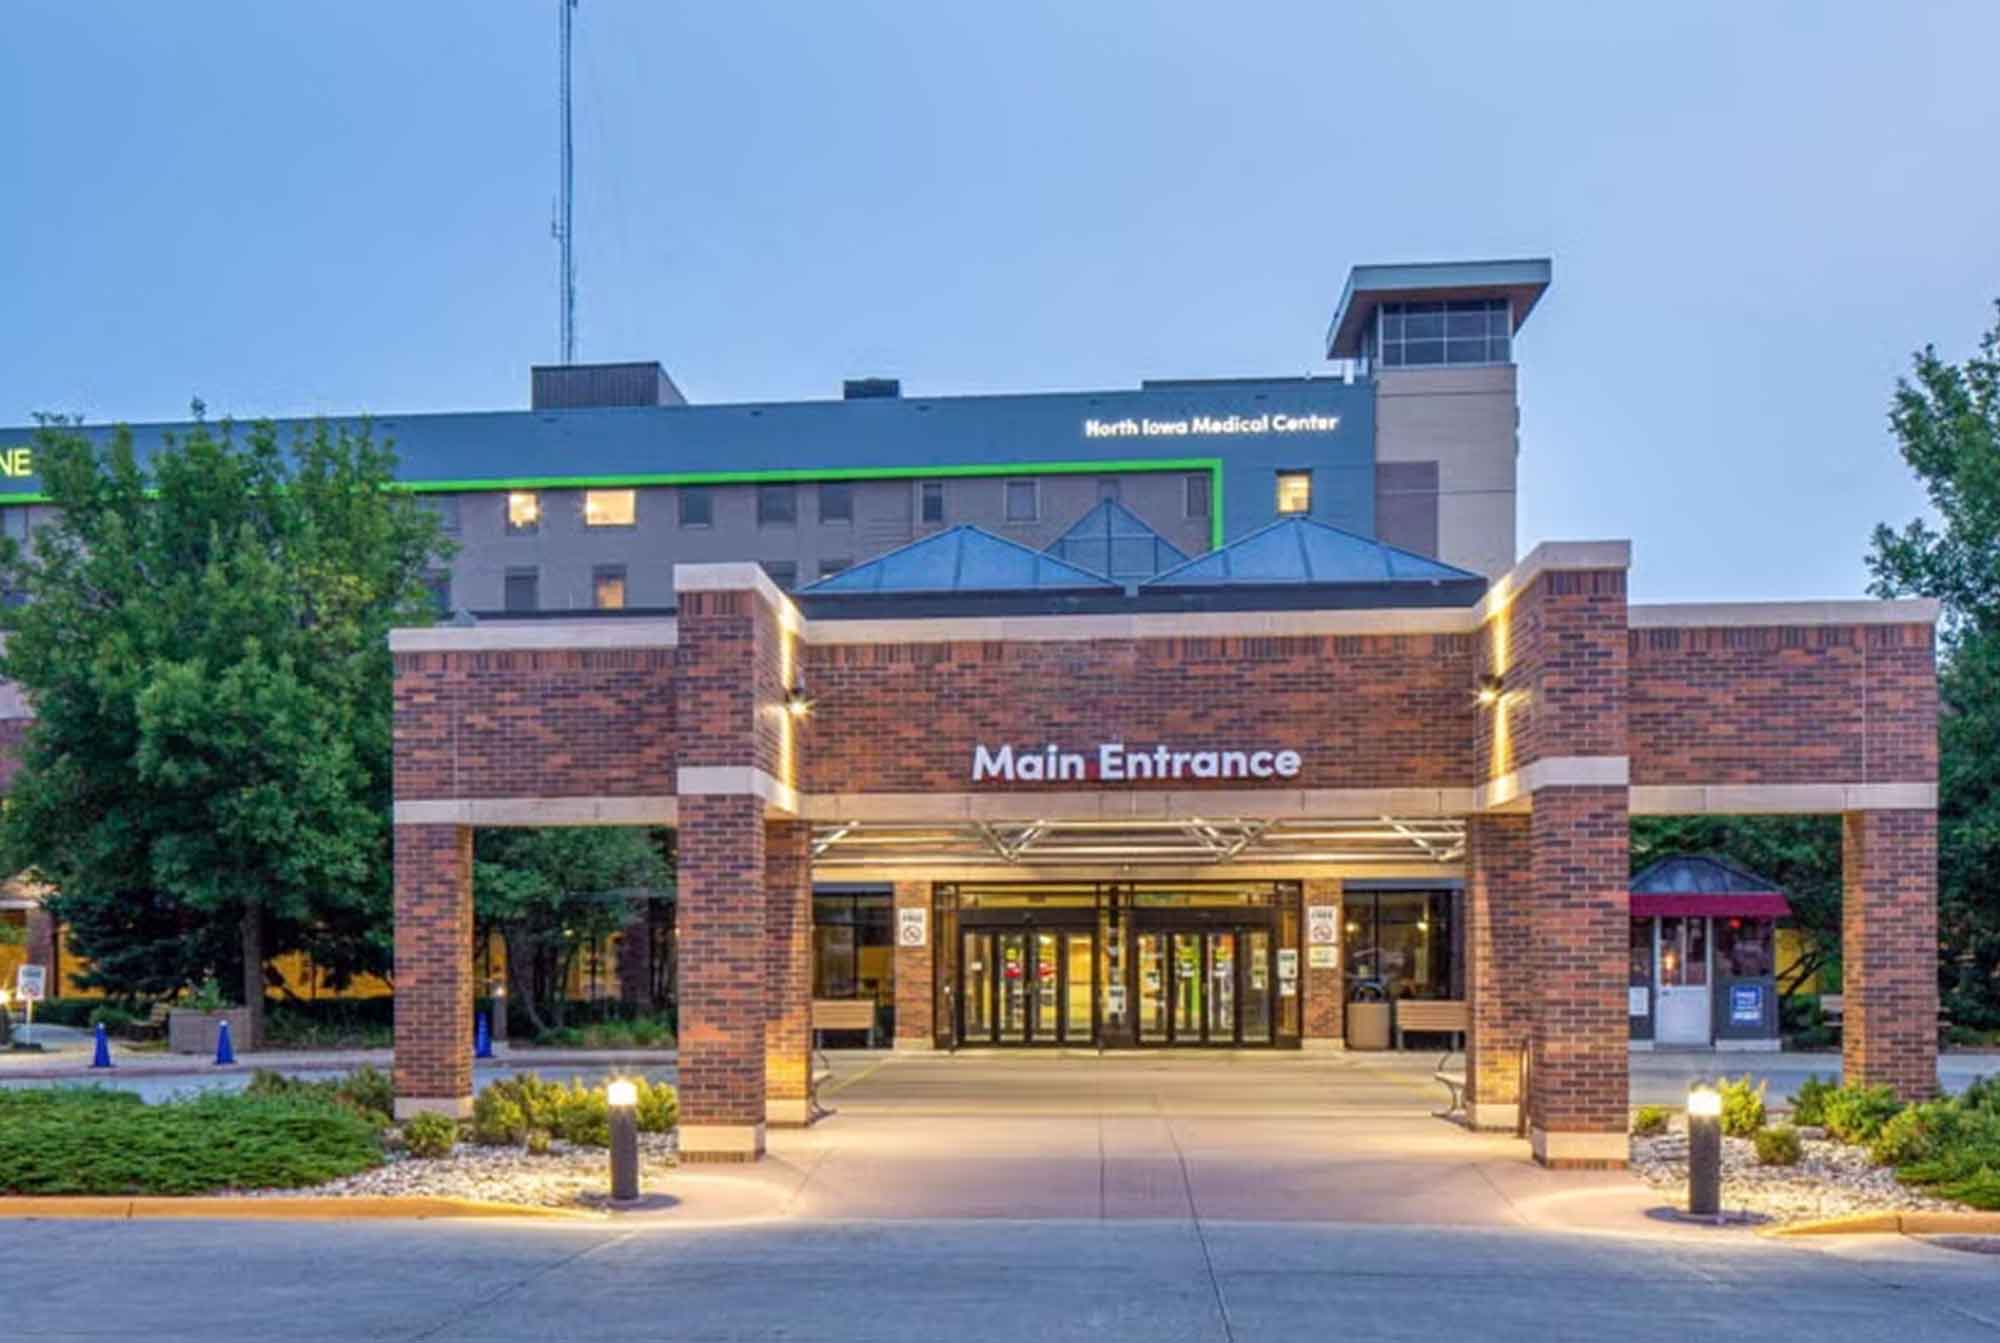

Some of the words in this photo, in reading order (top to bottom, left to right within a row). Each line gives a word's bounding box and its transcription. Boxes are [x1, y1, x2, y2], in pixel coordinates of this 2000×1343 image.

[1086, 419, 1138, 437] North
[1143, 418, 1187, 435] Iowa
[1191, 415, 1268, 433] Medical
[1272, 414, 1339, 432] Center
[973, 745, 1086, 781] Main
[1099, 744, 1301, 780] Entrance
